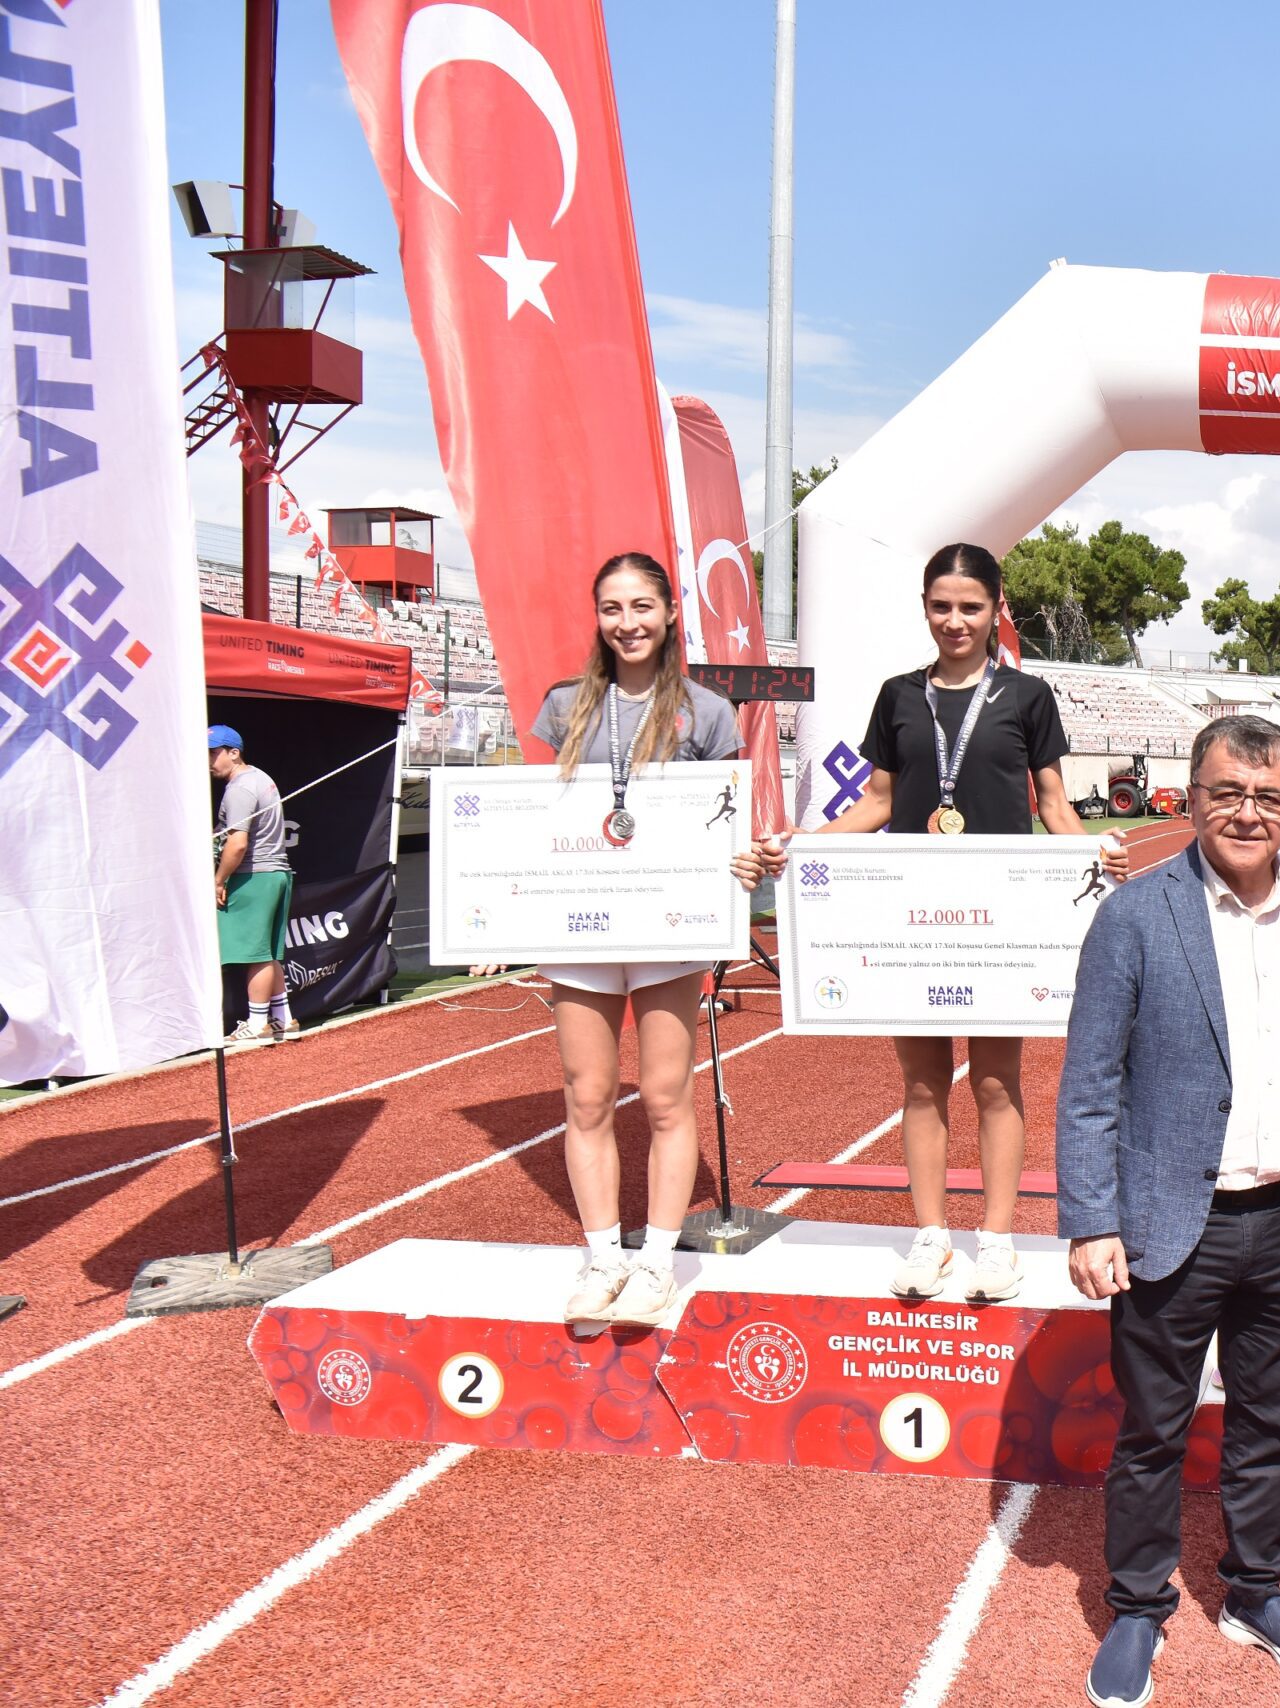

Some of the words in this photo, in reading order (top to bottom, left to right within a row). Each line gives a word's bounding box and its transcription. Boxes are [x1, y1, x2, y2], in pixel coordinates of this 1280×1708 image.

[219, 634, 263, 652] UNITED
[266, 640, 305, 658] TIMING
[365, 660, 397, 675] TIMING
[950, 750, 964, 779] TÜRKİYE
[551, 836, 604, 852] 10.000
[568, 912, 610, 921] HAKAN
[908, 909, 965, 925] 12.000
[969, 909, 994, 925] TL
[286, 911, 349, 949] ING
[835, 941, 879, 951] karşılığında
[880, 940, 907, 949] İSMAİL
[908, 942, 932, 950] AKÇAY
[956, 942, 983, 950] Koşusu
[928, 986, 973, 996] HAKAN
[867, 1310, 978, 1331] BALIKESİR
[828, 1334, 920, 1356] GENÇLİK
[925, 1339, 953, 1355] VE
[959, 1340, 1015, 1361] SPOR
[457, 1364, 483, 1403] 2
[842, 1359, 863, 1377] İL
[867, 1359, 999, 1386] MÜDÜRLÜĞÜ
[903, 1407, 923, 1448] 1
